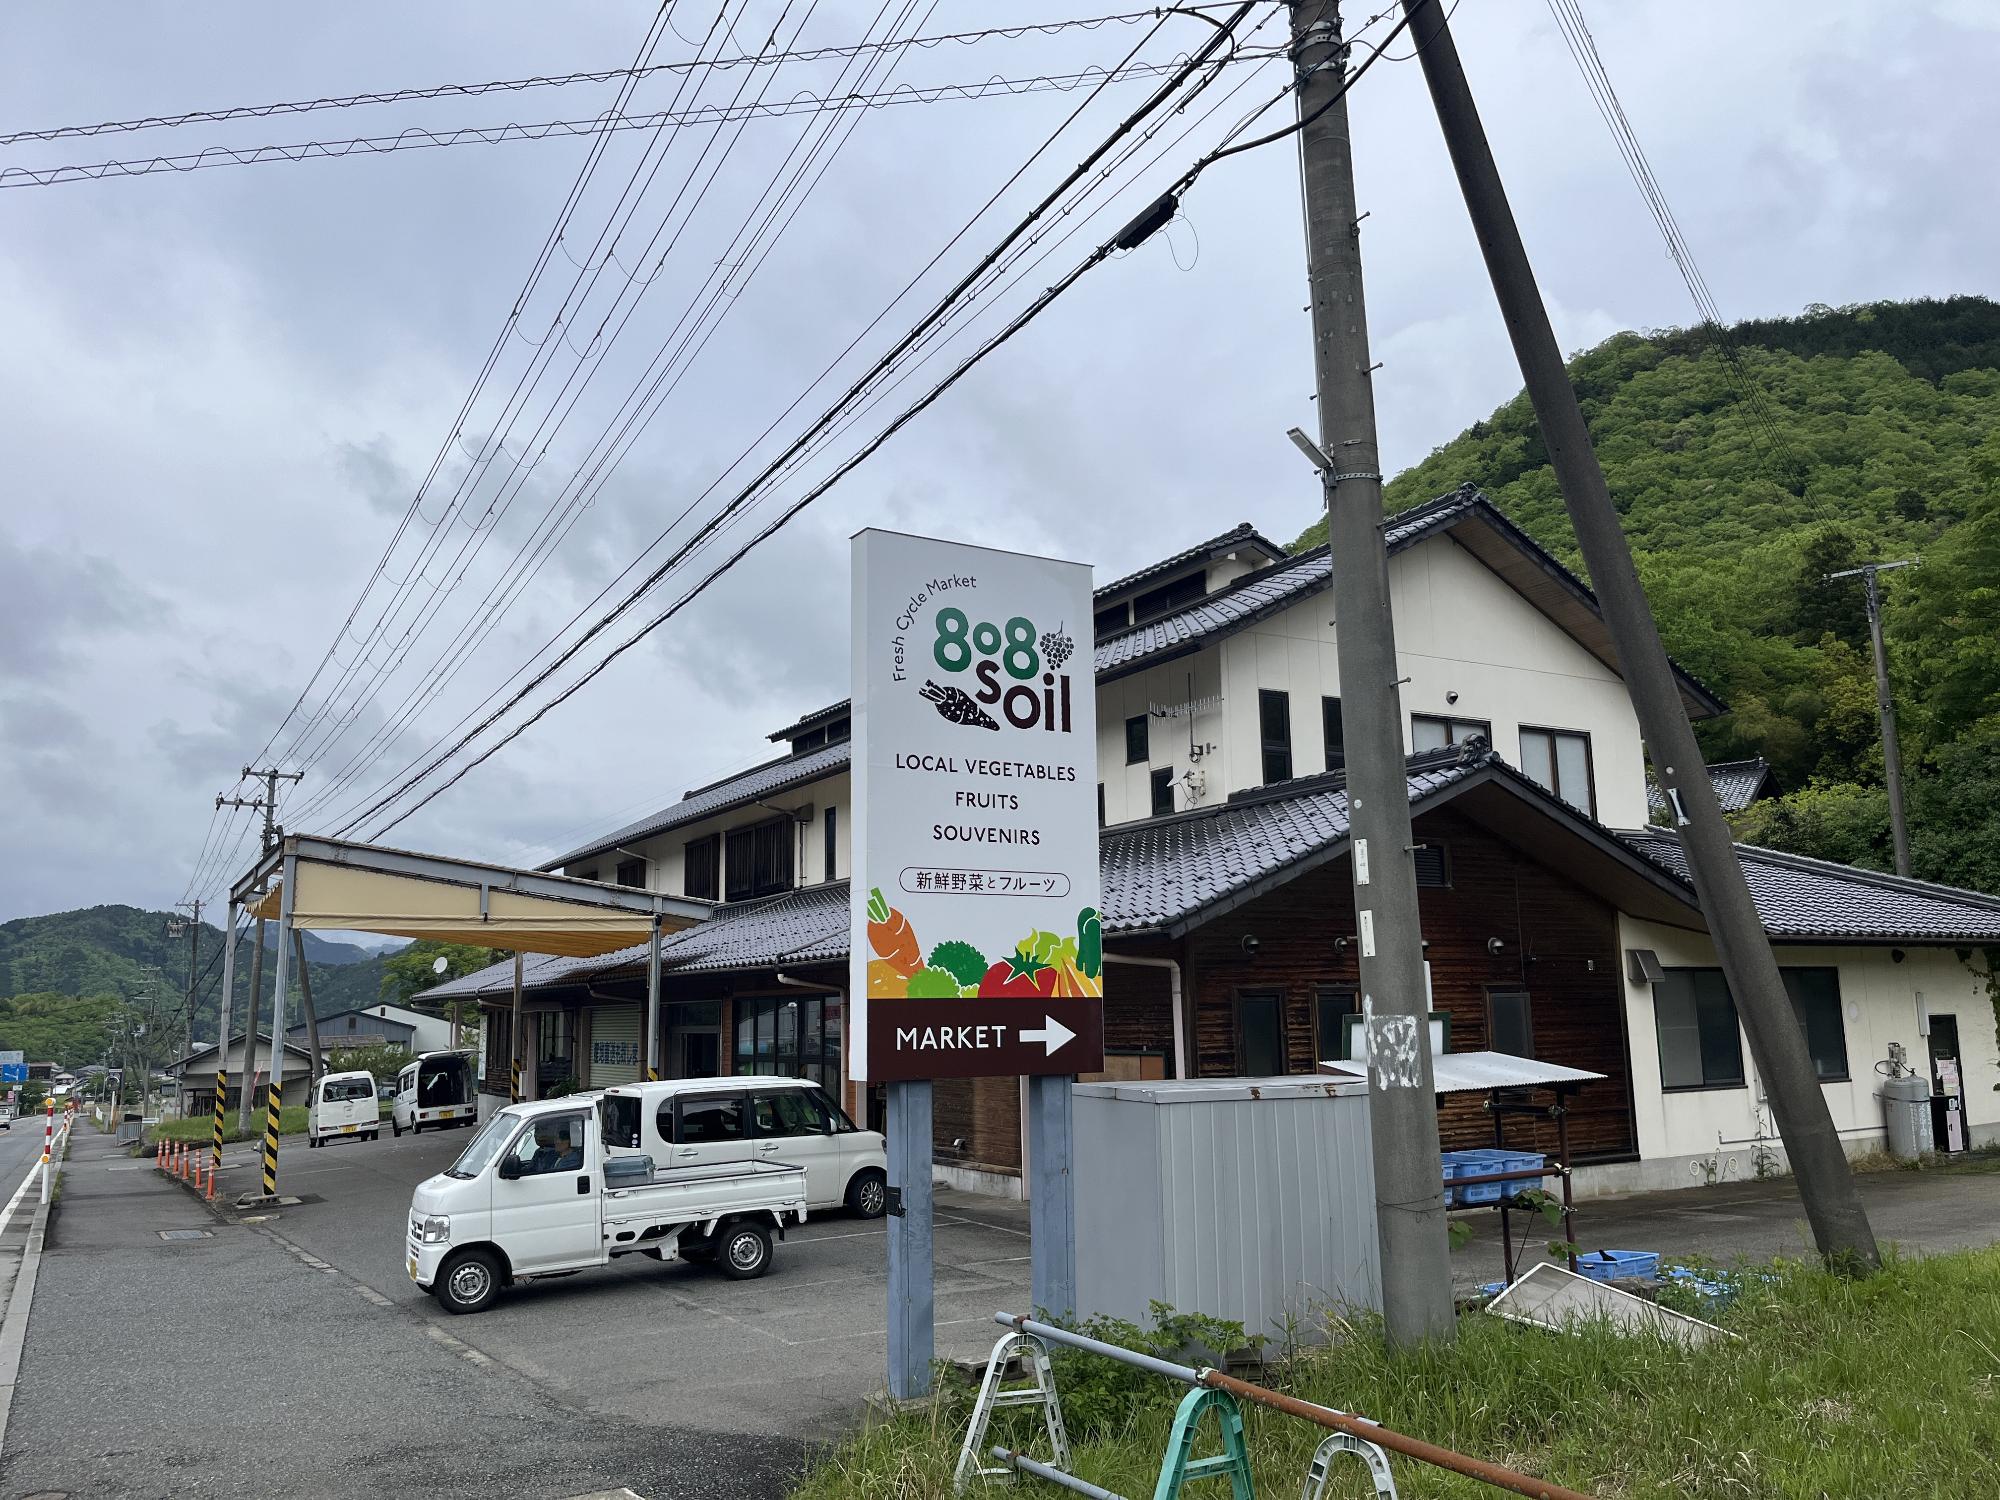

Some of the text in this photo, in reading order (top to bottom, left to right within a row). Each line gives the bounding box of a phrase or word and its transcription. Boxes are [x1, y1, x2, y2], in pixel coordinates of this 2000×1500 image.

[892, 573, 977, 682] Fresh Cycle Market
[933, 607, 1040, 680] 808
[896, 753, 1076, 782] LOCAL VEGETABLES
[955, 791, 1019, 810] FRUITS
[933, 824, 1040, 846] SOUVENIRS
[916, 871, 1056, 892] 新鮮野菜とフルーツ
[896, 1025, 1007, 1051] MARKET
